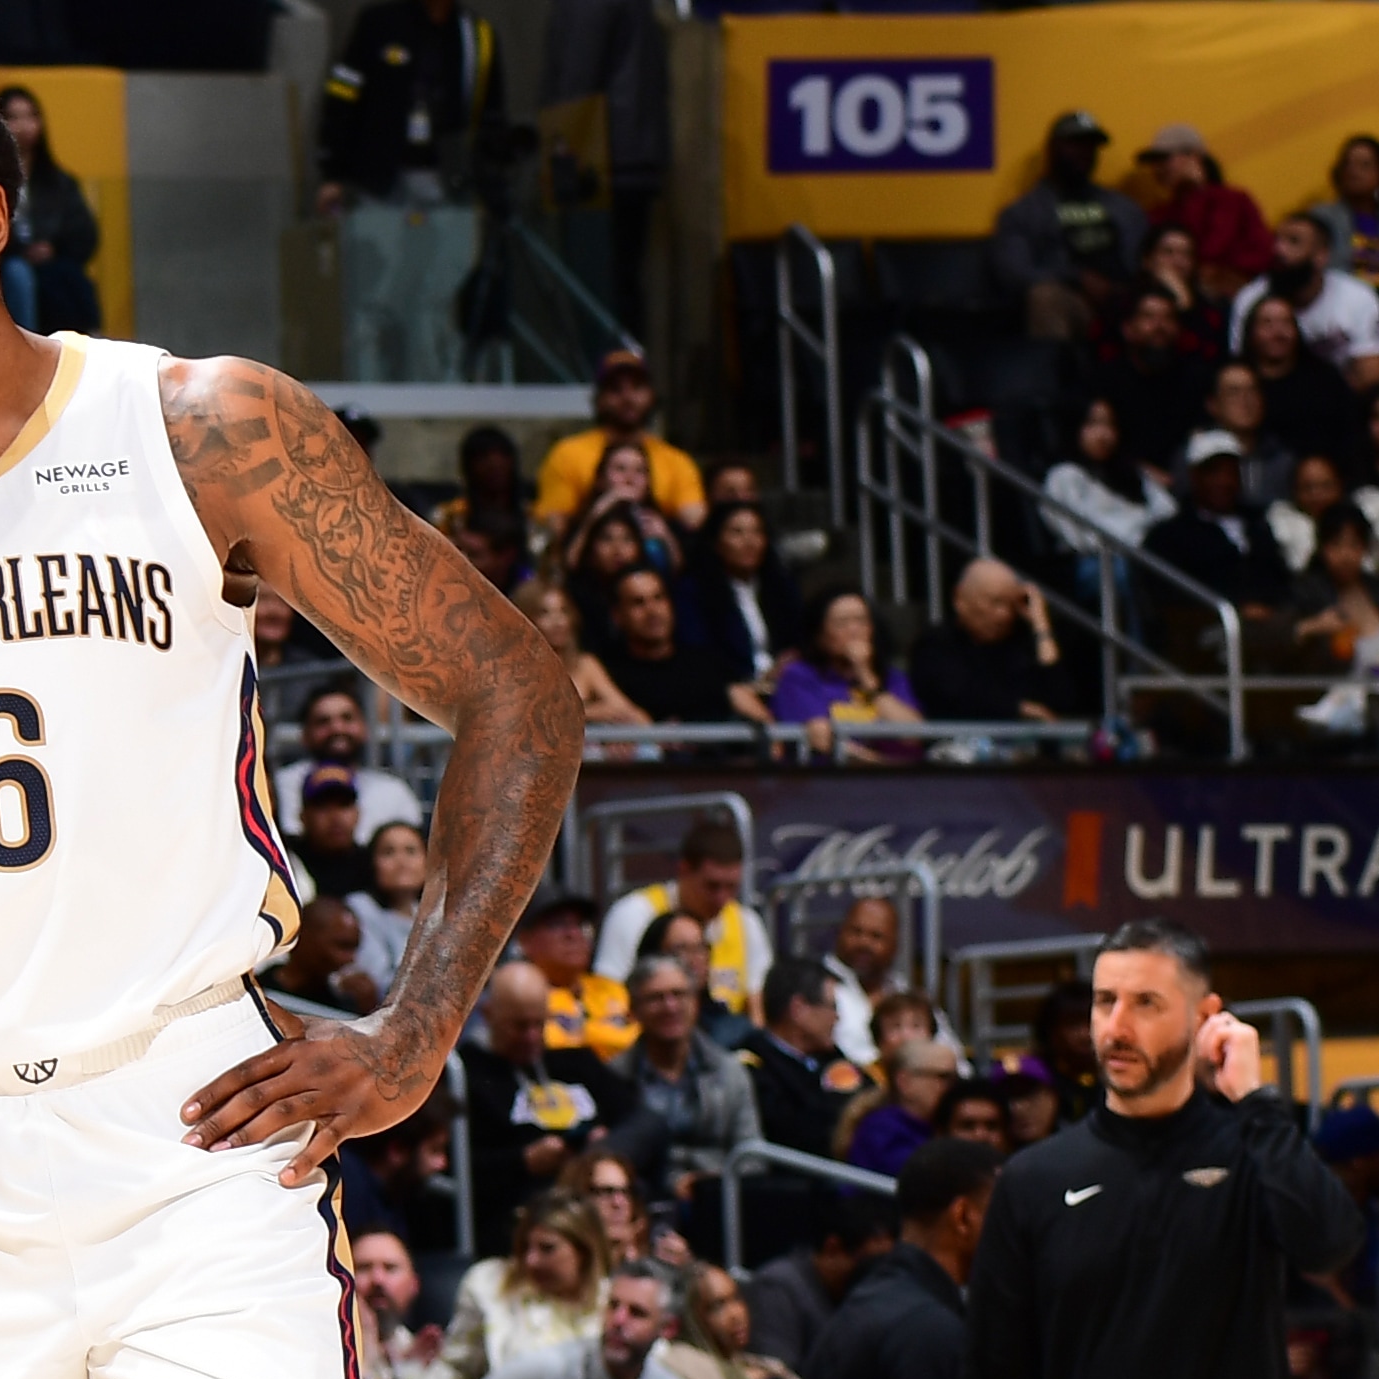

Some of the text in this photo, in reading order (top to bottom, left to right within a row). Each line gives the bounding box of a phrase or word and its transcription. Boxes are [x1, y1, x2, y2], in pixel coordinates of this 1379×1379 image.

[789, 74, 969, 157] 105
[35, 459, 129, 485] NEWAGE
[59, 482, 110, 494] GRILLS
